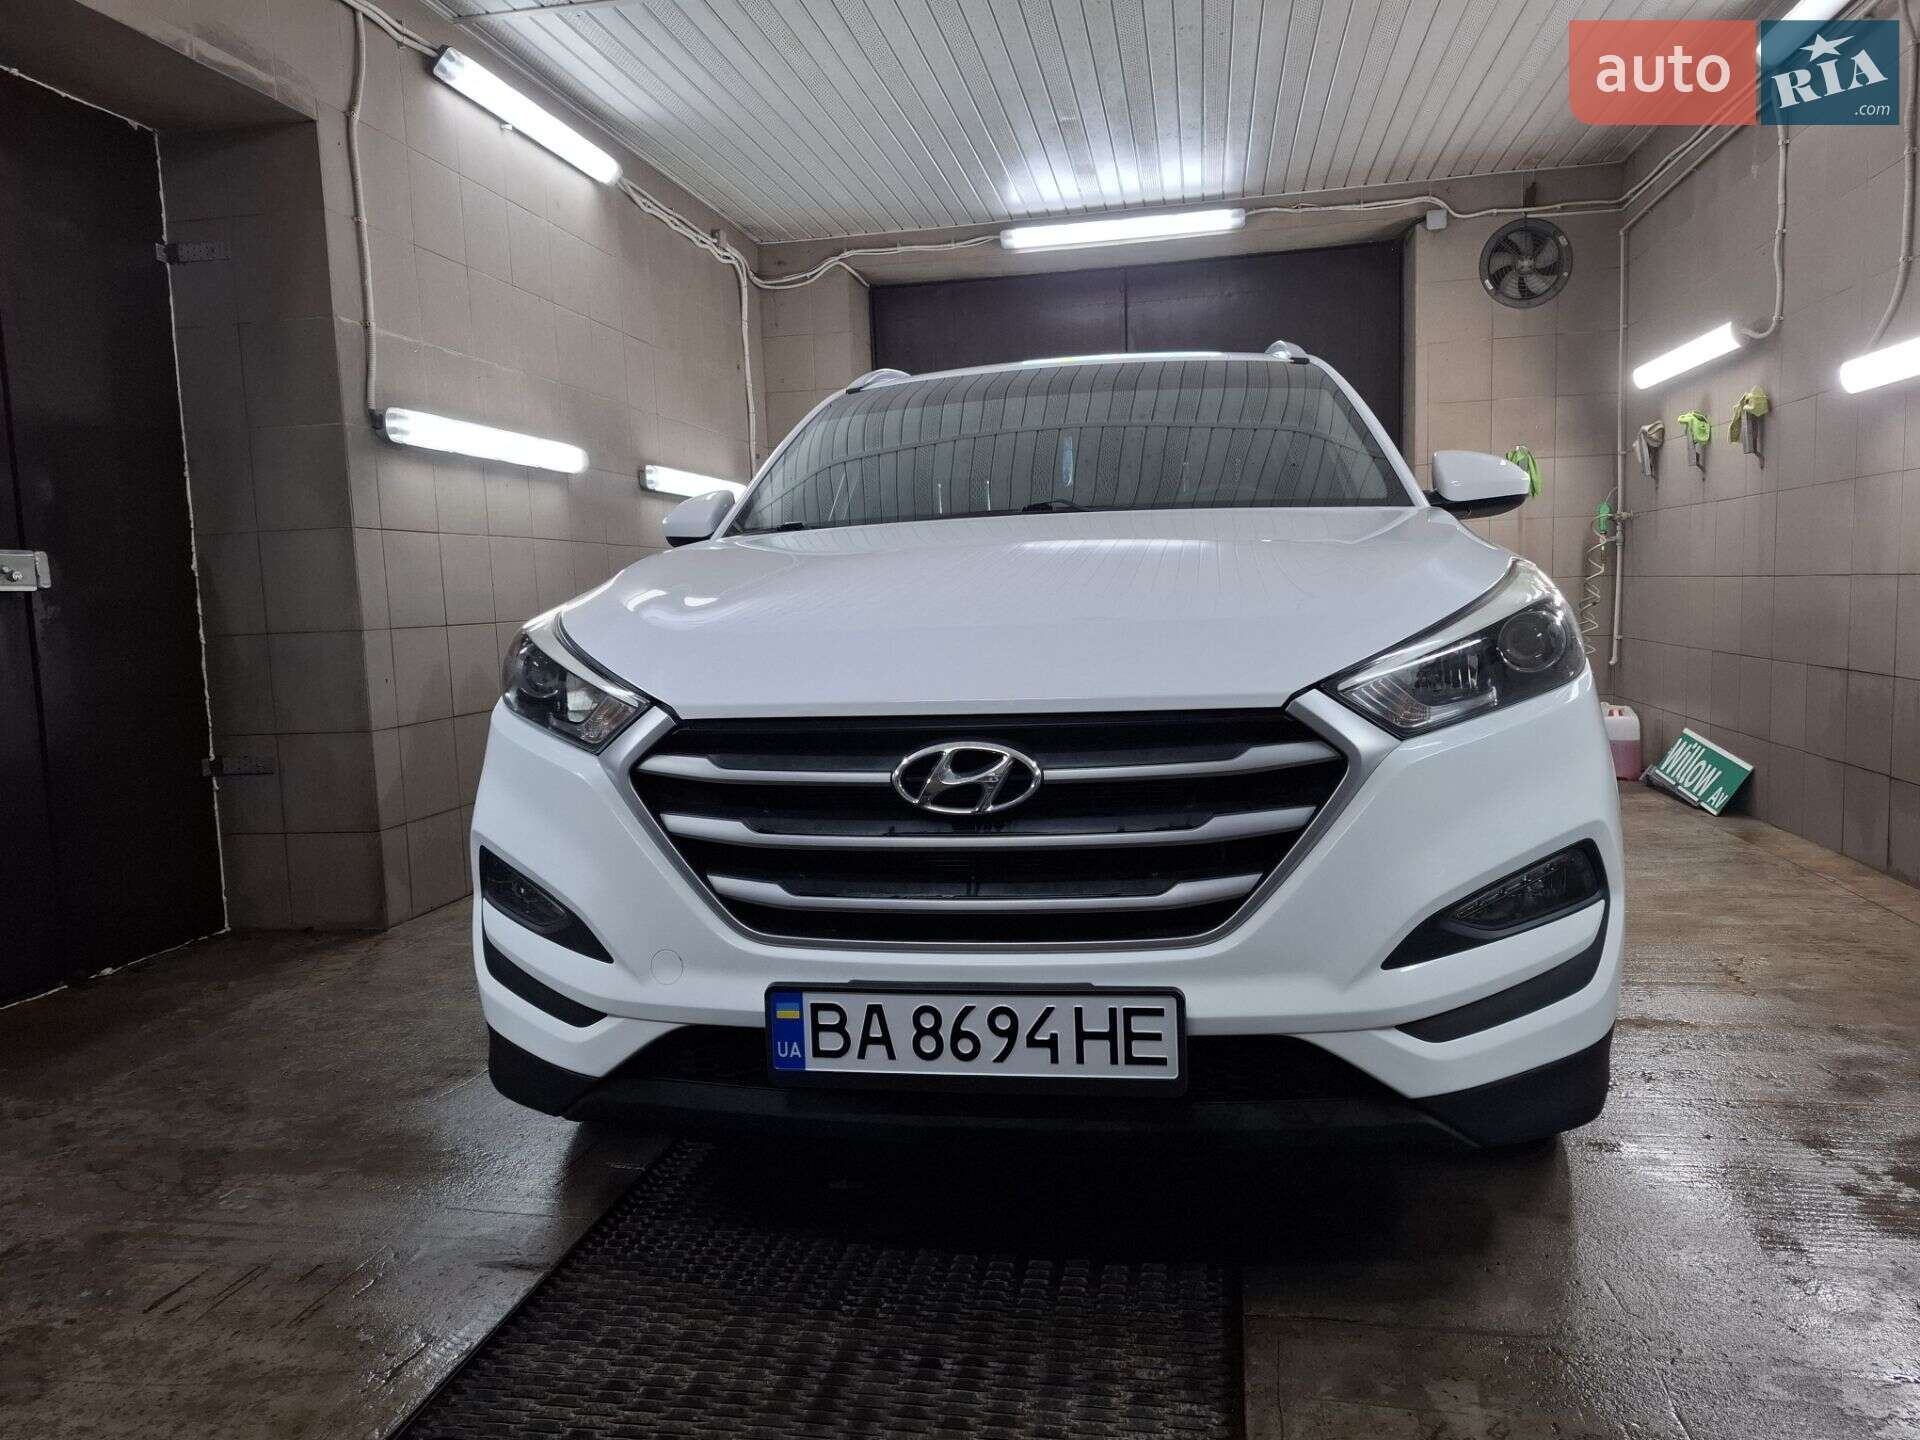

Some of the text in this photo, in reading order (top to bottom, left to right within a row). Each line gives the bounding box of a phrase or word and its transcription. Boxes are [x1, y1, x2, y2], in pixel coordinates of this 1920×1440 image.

[1661, 738, 1722, 796] Willow
[777, 1042, 801, 1058] UA
[810, 1002, 1168, 1066] BA 8694 HE
